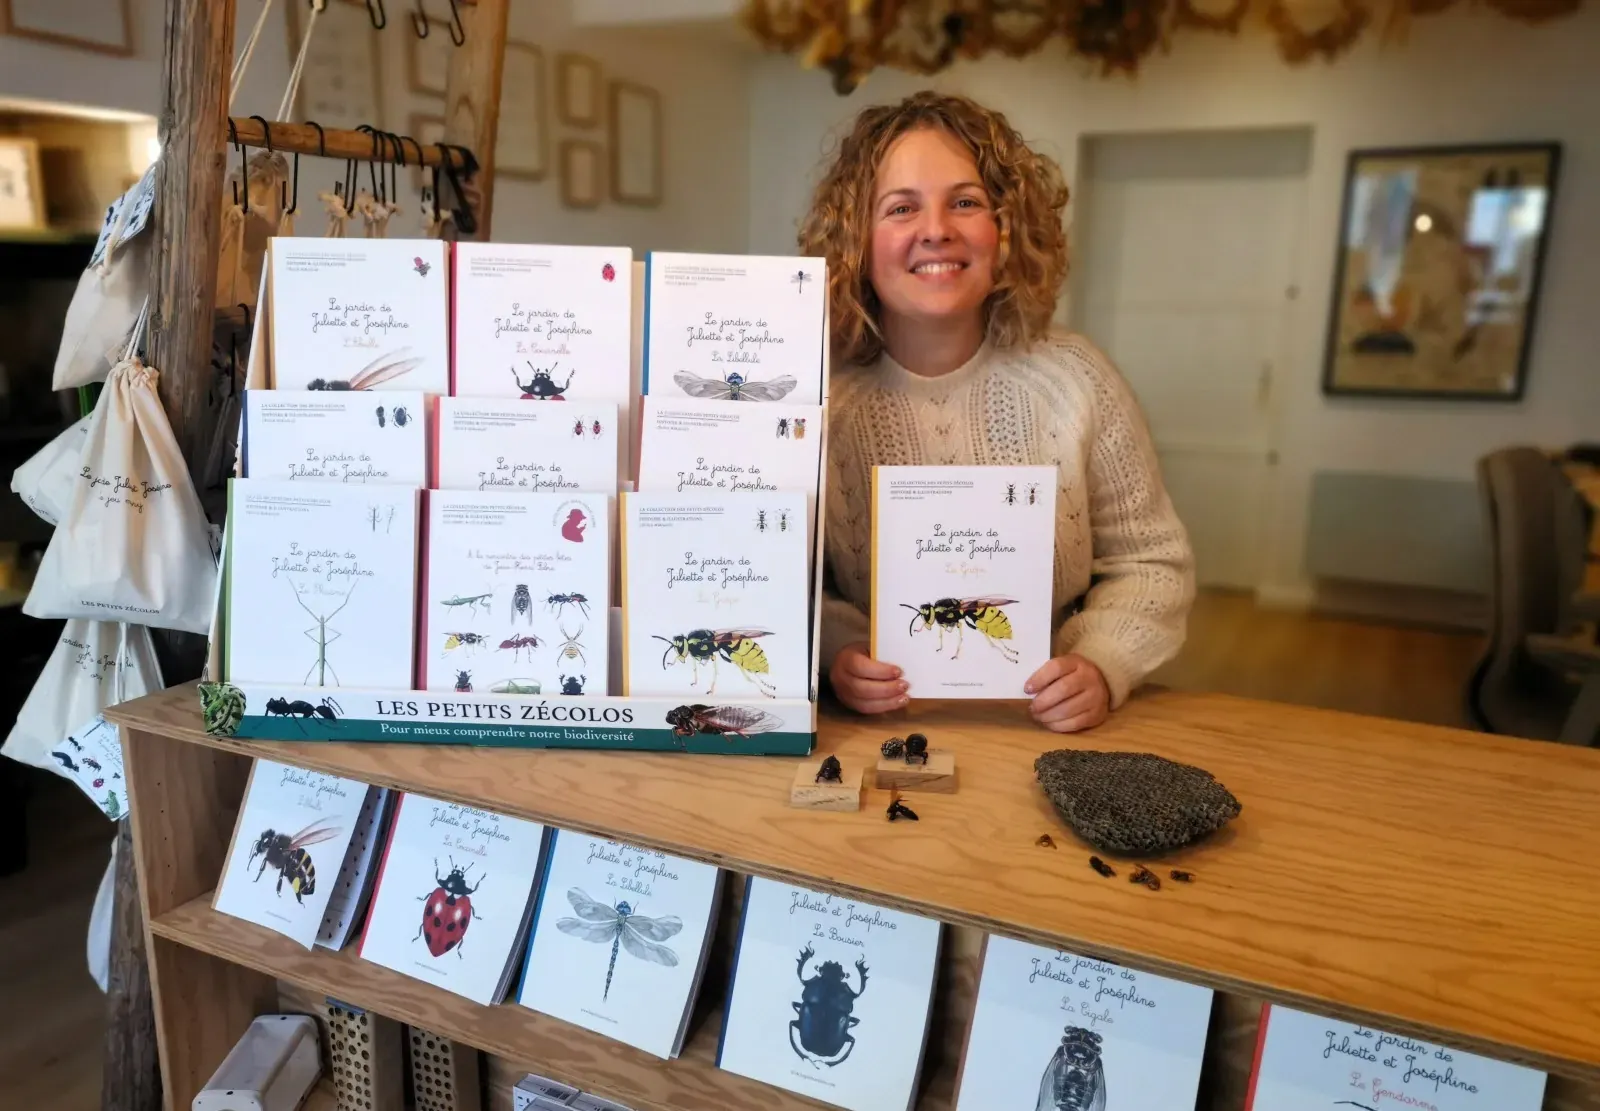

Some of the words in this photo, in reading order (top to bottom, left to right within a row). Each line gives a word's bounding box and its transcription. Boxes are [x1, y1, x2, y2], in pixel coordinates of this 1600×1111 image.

[329, 298, 341, 311] Le
[344, 303, 375, 318] jardin
[380, 304, 392, 312] de
[512, 303, 524, 317] Le
[527, 307, 559, 324] jardin
[563, 308, 575, 319] de
[311, 313, 347, 333] Juliette
[350, 319, 360, 327] et
[363, 315, 409, 335] Joséphine
[494, 318, 530, 339] Juliette
[533, 323, 542, 333] et
[546, 320, 593, 342] Joséphine
[704, 312, 717, 326] Le
[719, 317, 752, 333] jardin
[756, 318, 768, 328] de
[686, 326, 722, 348] Juliette
[725, 332, 735, 342] et
[738, 329, 785, 351] Joséphine
[711, 351, 723, 362] La
[726, 351, 761, 364] Libellule
[306, 448, 320, 462] Le
[322, 453, 355, 468] jardin
[359, 453, 371, 462] de
[496, 456, 509, 471] Le
[512, 462, 545, 478] jardin
[549, 462, 561, 473] de
[696, 457, 708, 471] Le
[711, 463, 744, 478] jardin
[748, 463, 760, 474] de
[288, 463, 325, 480] Juliette
[329, 468, 339, 478] et
[342, 464, 389, 483] Joséphine
[478, 471, 515, 491] Juliette
[518, 477, 528, 487] et
[531, 473, 580, 493] Joséphine
[677, 471, 713, 492] Juliette
[716, 478, 726, 488] et
[730, 475, 778, 492] Joséphine
[934, 524, 946, 537] Le
[949, 529, 982, 544] jardin
[986, 528, 998, 537] de
[290, 542, 303, 556] Le
[305, 549, 340, 564] jardin
[344, 548, 356, 560] de
[916, 539, 951, 559] Juliette
[955, 545, 964, 553] et
[969, 539, 1016, 560] Joséphine
[272, 557, 308, 579] Juliette
[312, 564, 322, 574] et
[326, 560, 375, 582] Joséphine
[684, 552, 698, 566] Le
[700, 557, 734, 572] jardin
[738, 556, 751, 566] de
[667, 568, 703, 589] Juliette
[707, 571, 717, 582] et
[721, 568, 769, 589] Joséphine
[81, 600, 95, 608] LES
[97, 602, 123, 611] PETITS
[124, 604, 160, 615] ZÉCOLOS
[376, 700, 418, 716] LES
[427, 702, 512, 720] PETITS
[521, 701, 634, 723] ZÉCOLOS
[381, 723, 409, 735] Pour
[413, 724, 450, 736] mieux
[453, 724, 526, 740] comprendre
[529, 728, 561, 739] notre
[564, 727, 634, 742] biodiversité
[459, 802, 488, 820] jardin
[490, 810, 499, 821] de
[430, 807, 459, 828] Juliette
[462, 821, 470, 830] et
[471, 819, 510, 844] Joséphine
[443, 835, 453, 848] La
[587, 843, 620, 865] Juliette
[623, 858, 632, 868] et
[634, 855, 679, 882] Joséphine
[605, 873, 617, 887] La
[620, 876, 652, 897] Libellule
[789, 891, 828, 914] Juliette
[831, 908, 842, 917] et
[845, 904, 897, 932] Joséphine
[813, 923, 825, 937] Le
[828, 926, 865, 947] Bousier
[1072, 955, 1116, 975] jardin
[1120, 968, 1136, 982] de
[1028, 957, 1074, 983] Juliette
[1078, 979, 1091, 990] et
[1094, 975, 1156, 1009] Joséphine
[1060, 996, 1075, 1013] La
[1080, 1001, 1114, 1026] Cigale
[1374, 1032, 1428, 1055] jardin
[1434, 1047, 1453, 1063] de
[1323, 1030, 1377, 1059] Juliette
[1383, 1057, 1398, 1068] et
[1402, 1054, 1480, 1093] Joséphine
[1349, 1071, 1367, 1091] Le
[1371, 1077, 1439, 1111] Gendarme
